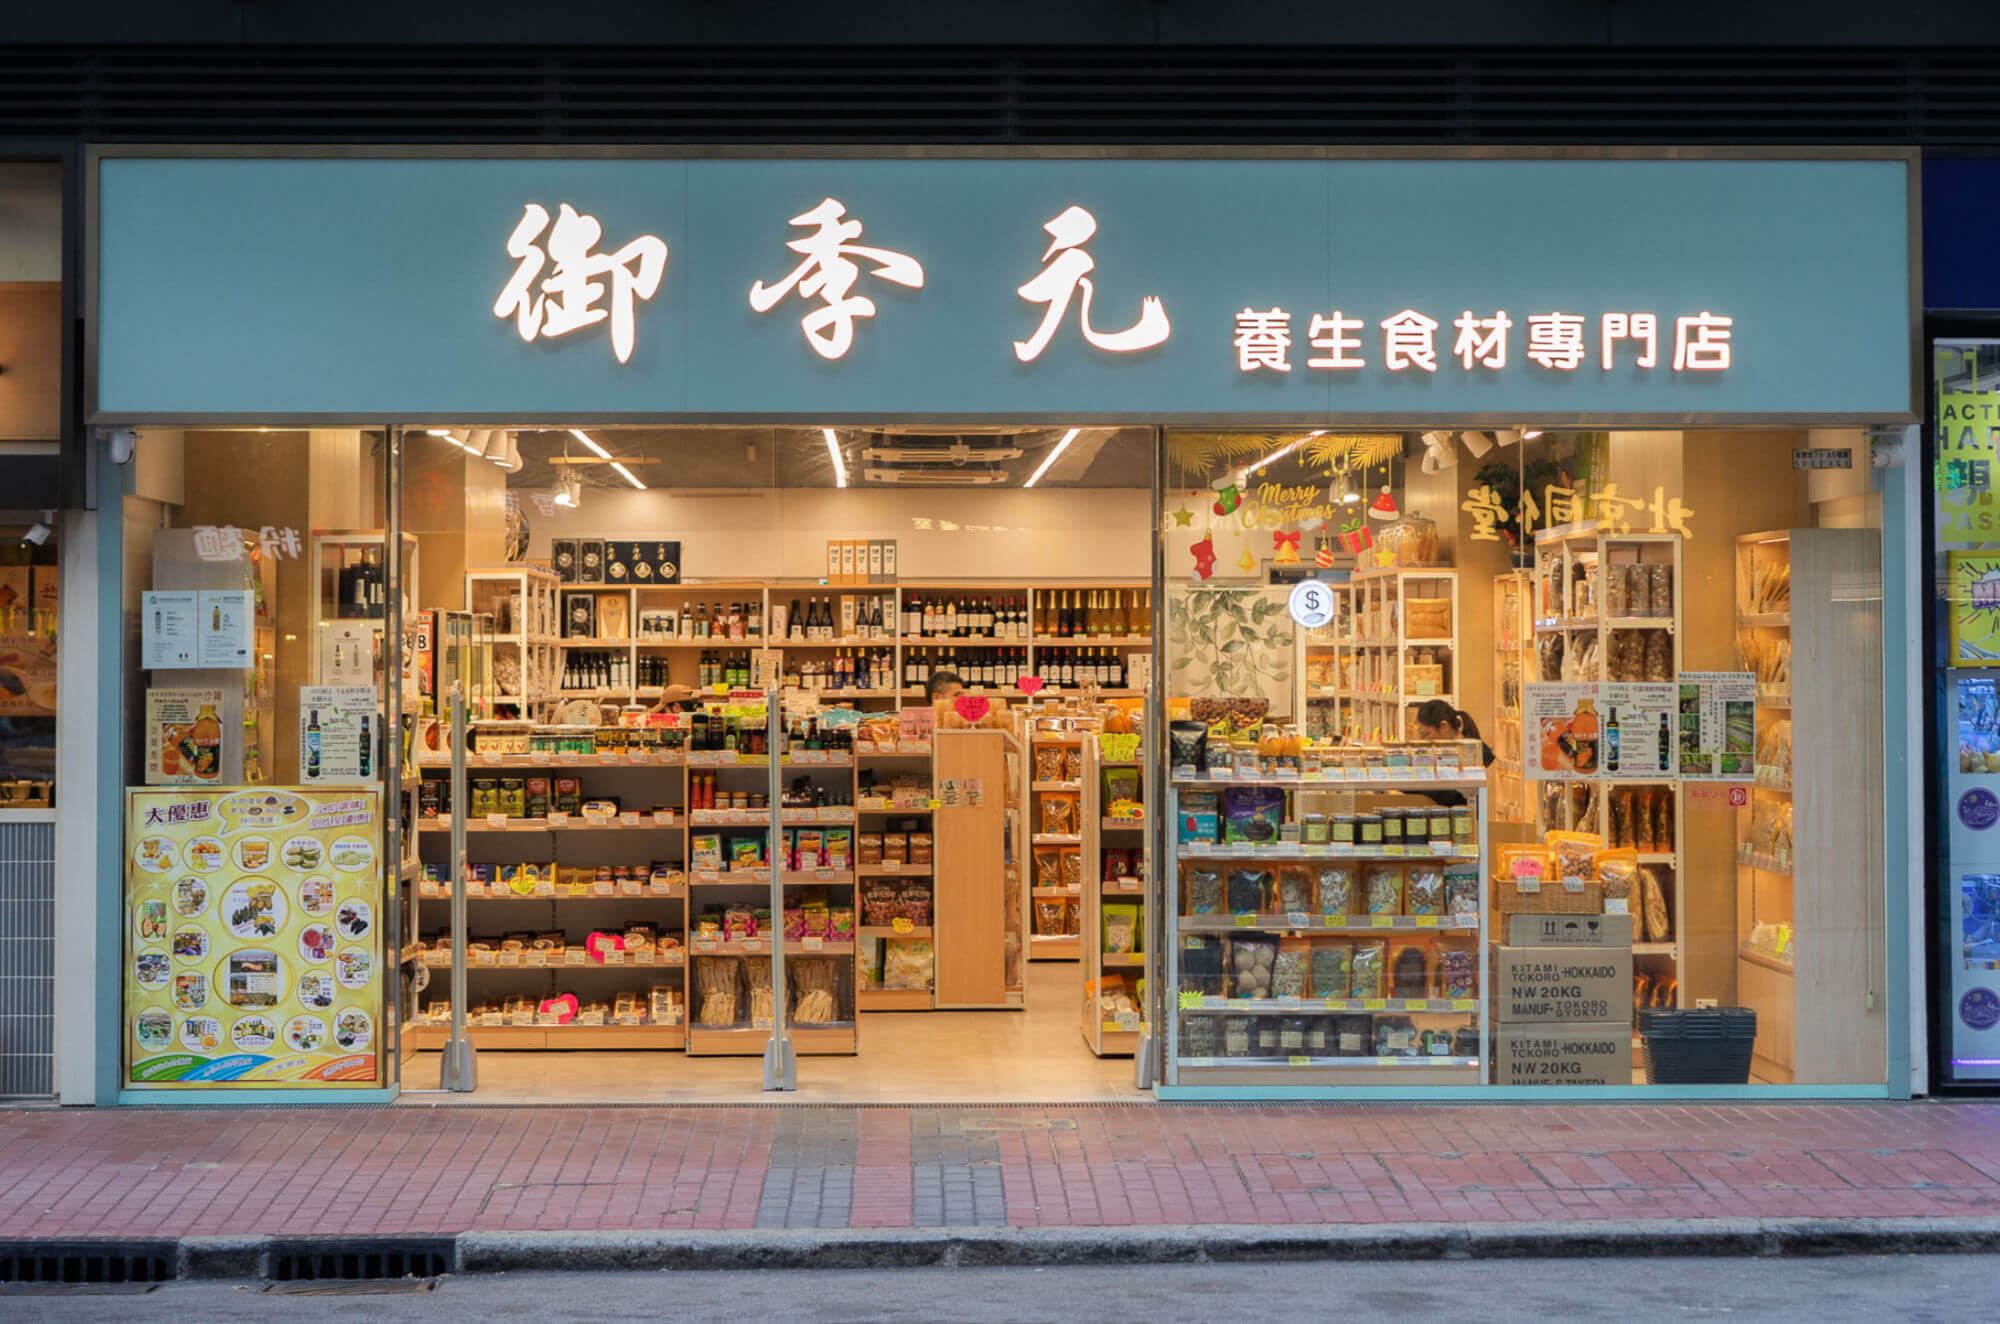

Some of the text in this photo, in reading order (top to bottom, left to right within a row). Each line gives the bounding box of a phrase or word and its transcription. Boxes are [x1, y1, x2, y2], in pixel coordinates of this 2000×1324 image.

[494, 198, 1170, 363] 御季元
[1233, 306, 1733, 372] 養生食材專門店
[1257, 482, 1320, 506] Merry
[1241, 501, 1336, 528] Christmas
[1511, 964, 1557, 972] KITAMI
[1511, 986, 1582, 998] NW 20KG
[1511, 1040, 1557, 1048] KITAMI
[1511, 1062, 1582, 1074] NW 20KG
